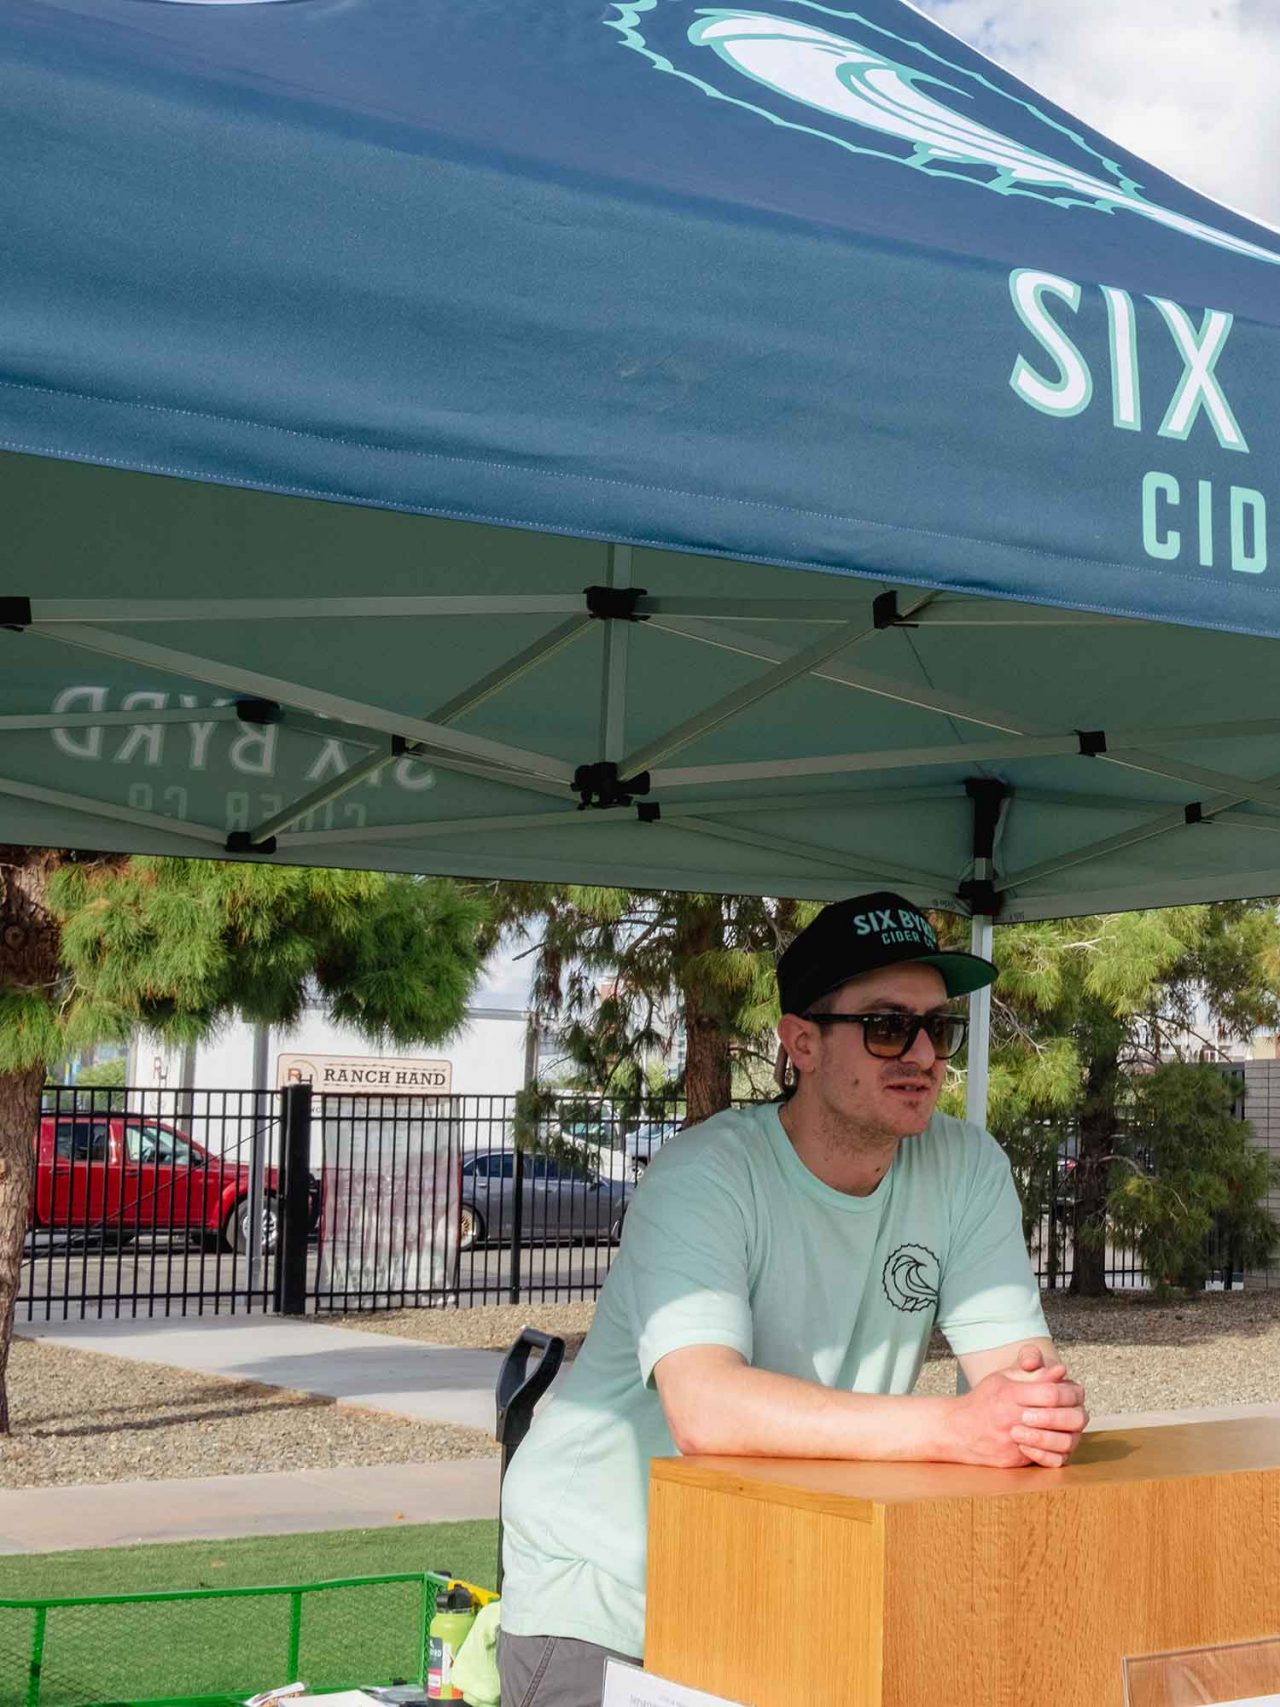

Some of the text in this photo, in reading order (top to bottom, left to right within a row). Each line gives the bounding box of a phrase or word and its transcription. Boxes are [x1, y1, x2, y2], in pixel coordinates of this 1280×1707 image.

[1009, 268, 1249, 454] SIX
[853, 909, 898, 935] SIX
[881, 930, 921, 945] CIDER
[323, 1067, 447, 1087] RANCH HAND
